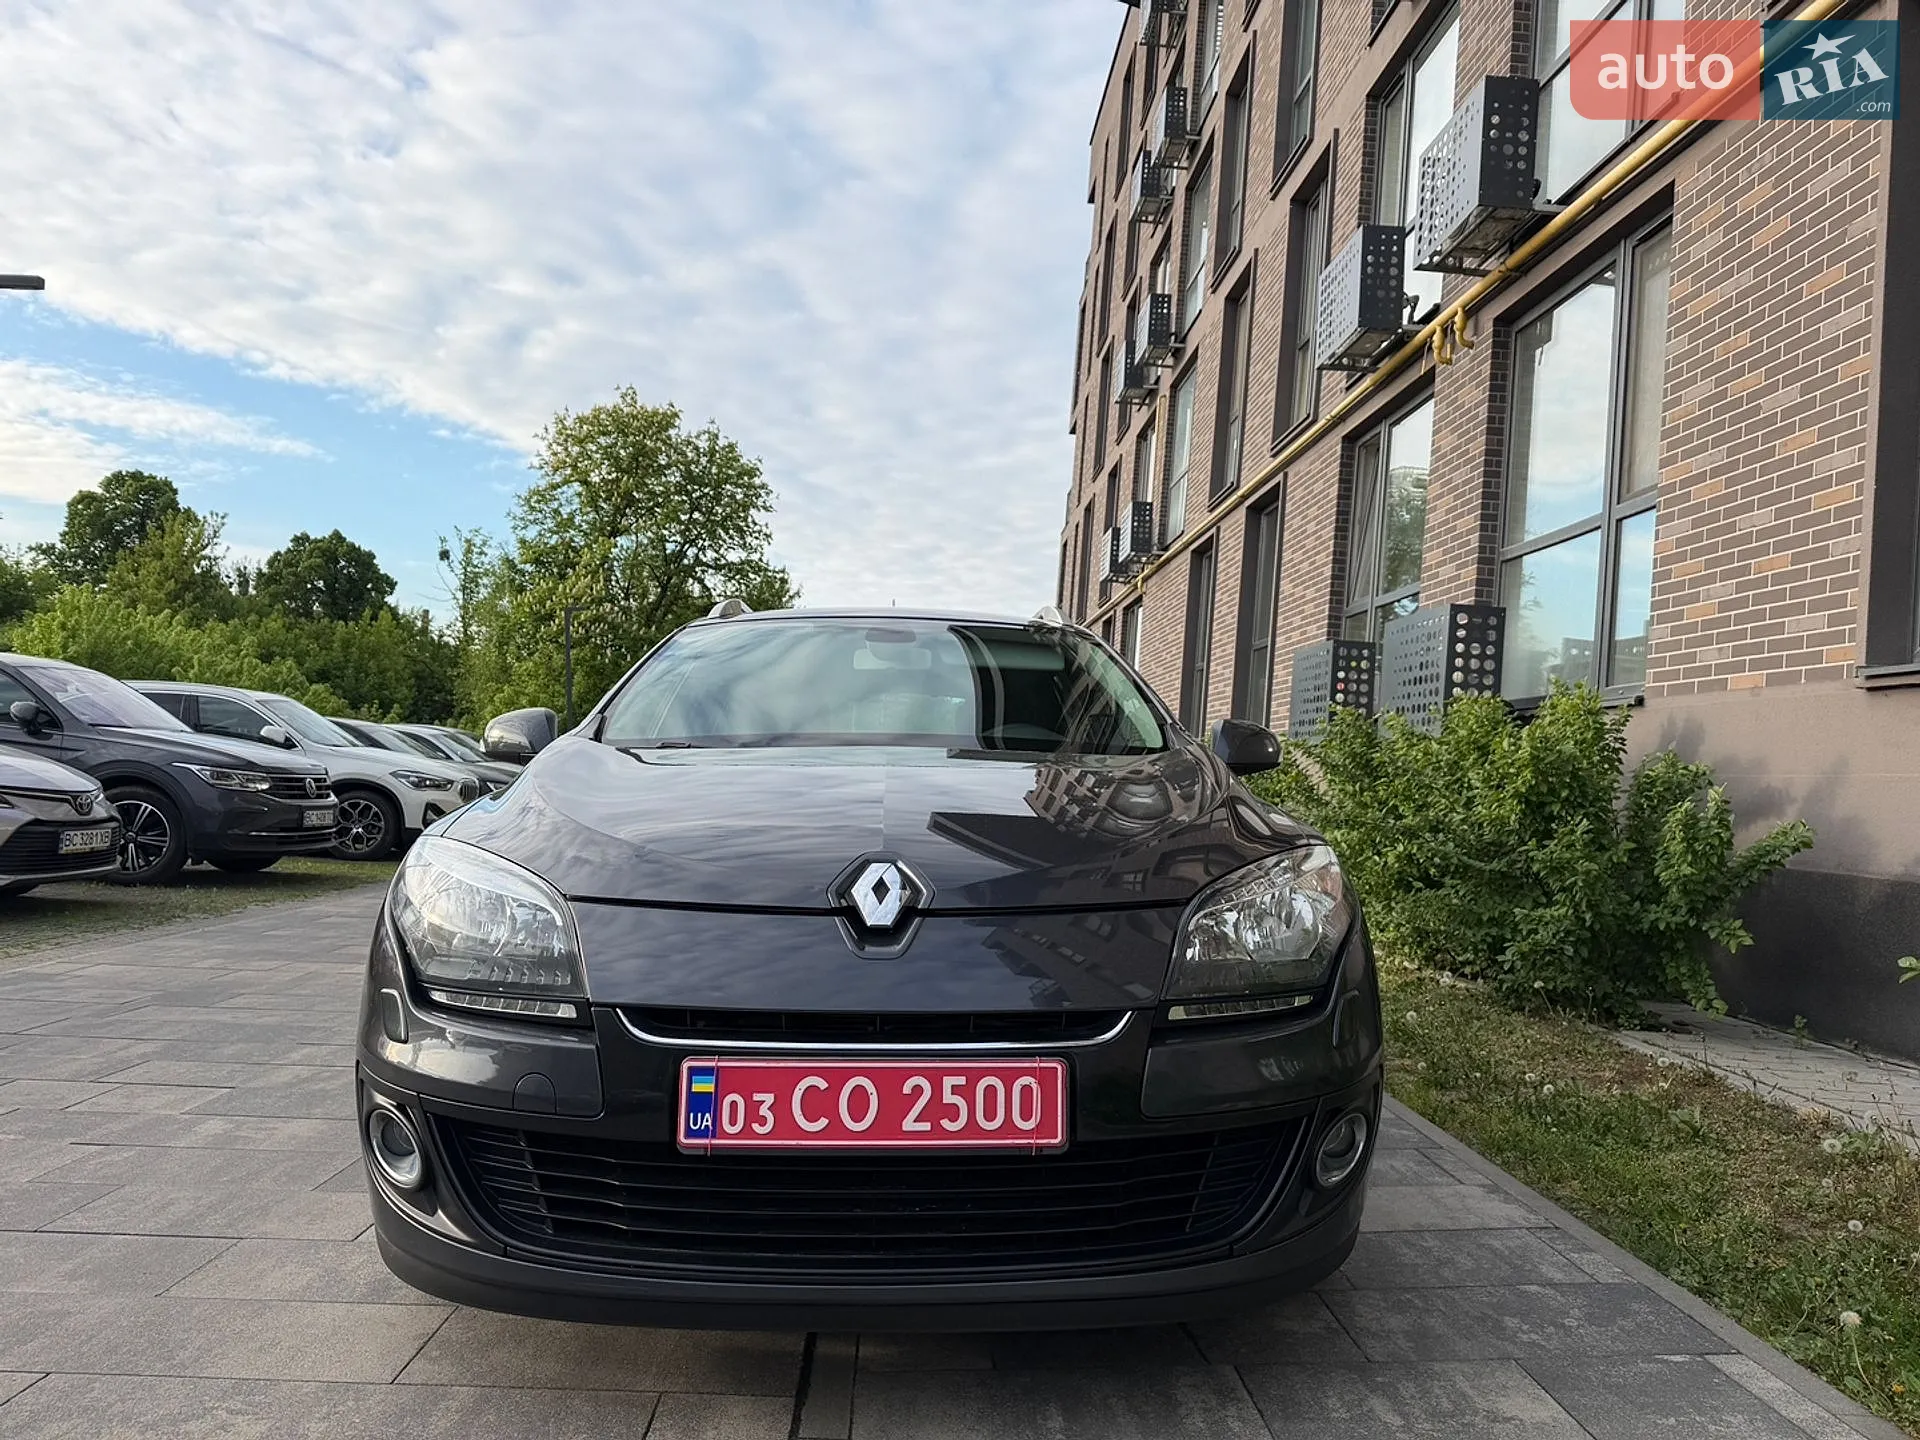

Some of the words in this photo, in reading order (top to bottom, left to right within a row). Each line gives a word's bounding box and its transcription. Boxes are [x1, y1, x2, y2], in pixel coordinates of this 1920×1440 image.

[64, 833, 78, 847] BC
[721, 1093, 775, 1135] 03
[791, 1075, 879, 1132] CO
[901, 1076, 1041, 1132] 2500
[689, 1112, 713, 1130] UA
